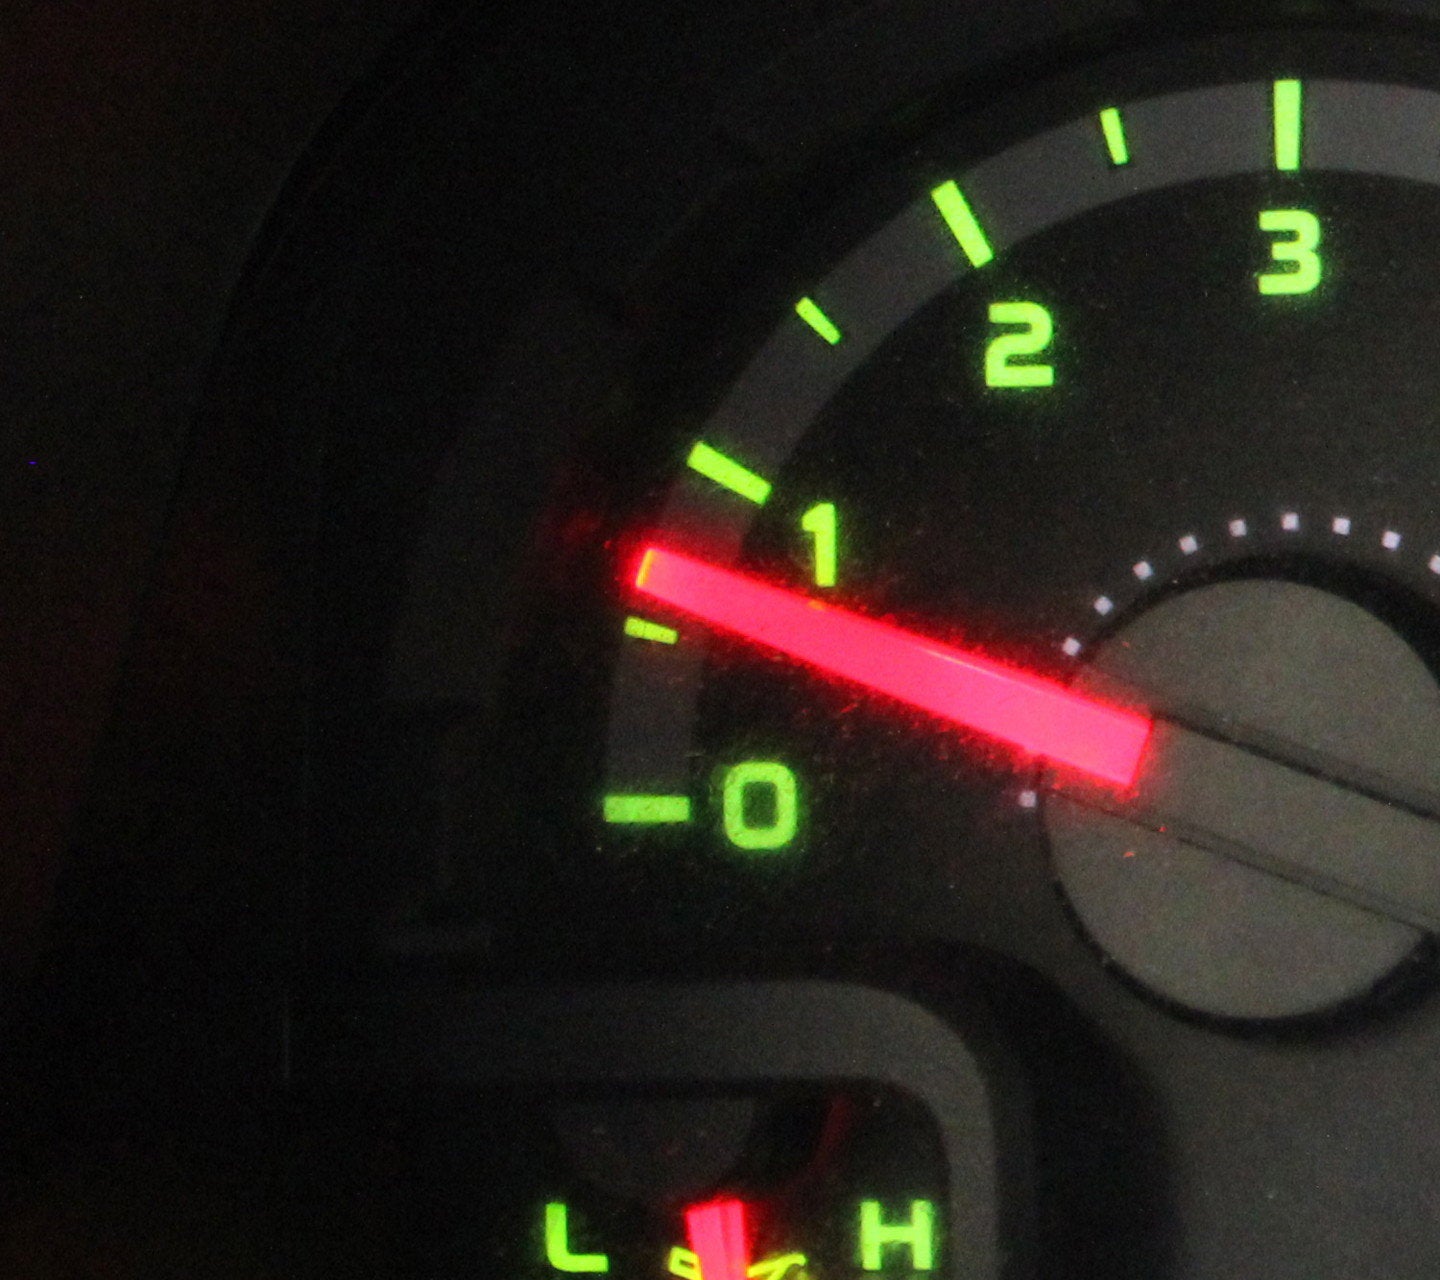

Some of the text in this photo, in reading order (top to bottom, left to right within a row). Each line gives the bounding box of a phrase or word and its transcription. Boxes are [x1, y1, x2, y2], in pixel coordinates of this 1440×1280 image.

[1257, 208, 1323, 297] 3
[983, 299, 1056, 389] 2
[800, 501, 839, 588] 1
[722, 761, 799, 851] 0
[544, 1202, 609, 1273] L
[859, 1200, 935, 1271] H
